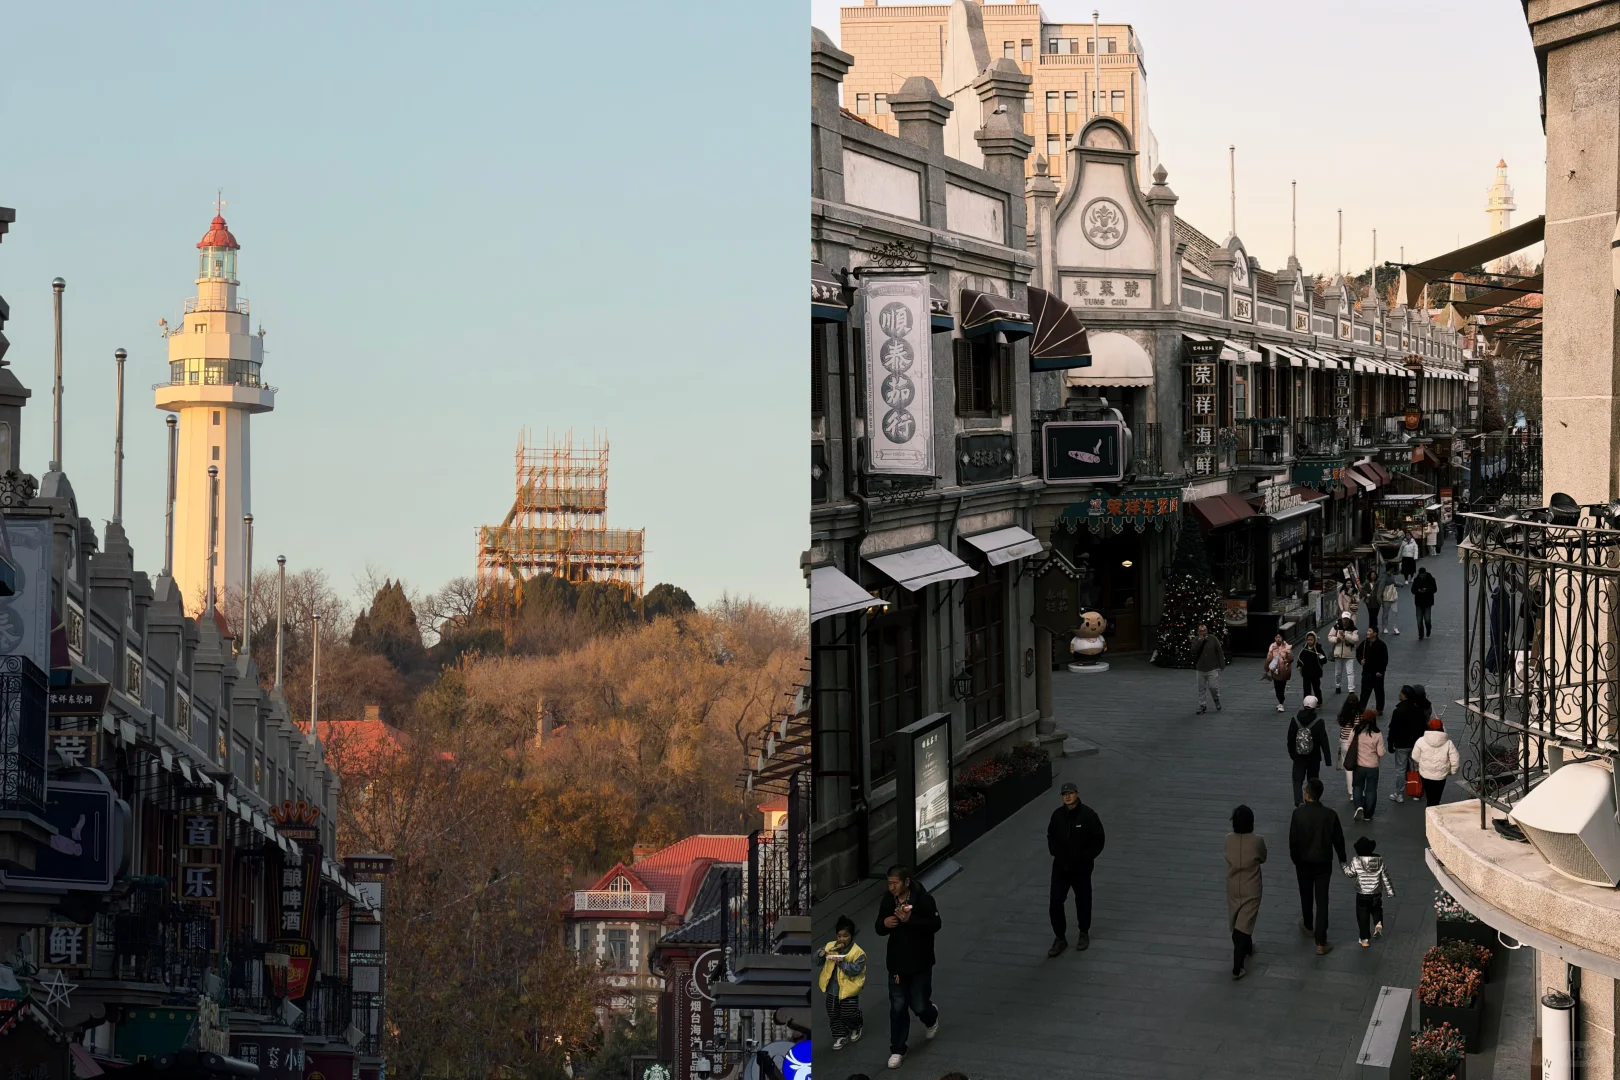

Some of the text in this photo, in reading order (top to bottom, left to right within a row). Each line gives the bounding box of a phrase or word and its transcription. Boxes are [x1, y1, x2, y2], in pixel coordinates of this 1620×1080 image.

[1083, 298, 1128, 306] TUNG CHU
[1195, 366, 1212, 475] 荣祥海鲜
